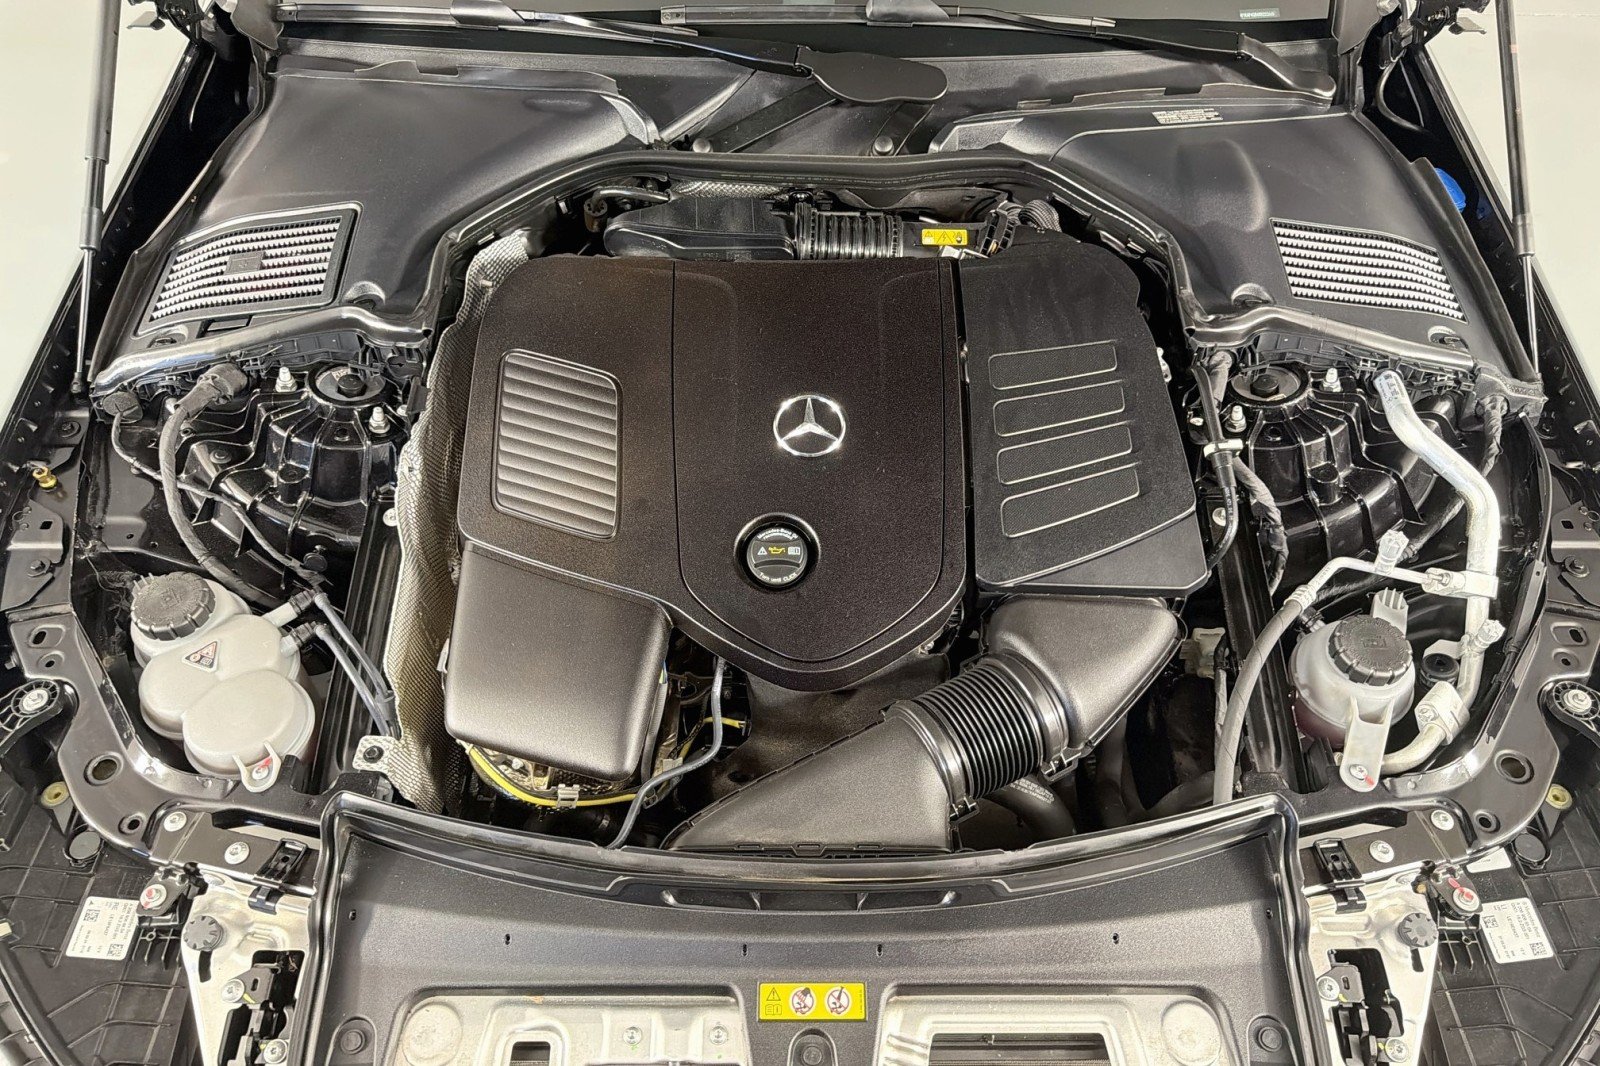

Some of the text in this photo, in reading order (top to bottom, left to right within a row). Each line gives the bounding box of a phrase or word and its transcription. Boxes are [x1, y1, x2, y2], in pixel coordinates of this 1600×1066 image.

[757, 528, 792, 539] Mercedes-Benz
[759, 572, 770, 580] Turn
[783, 572, 799, 582] CLICK
